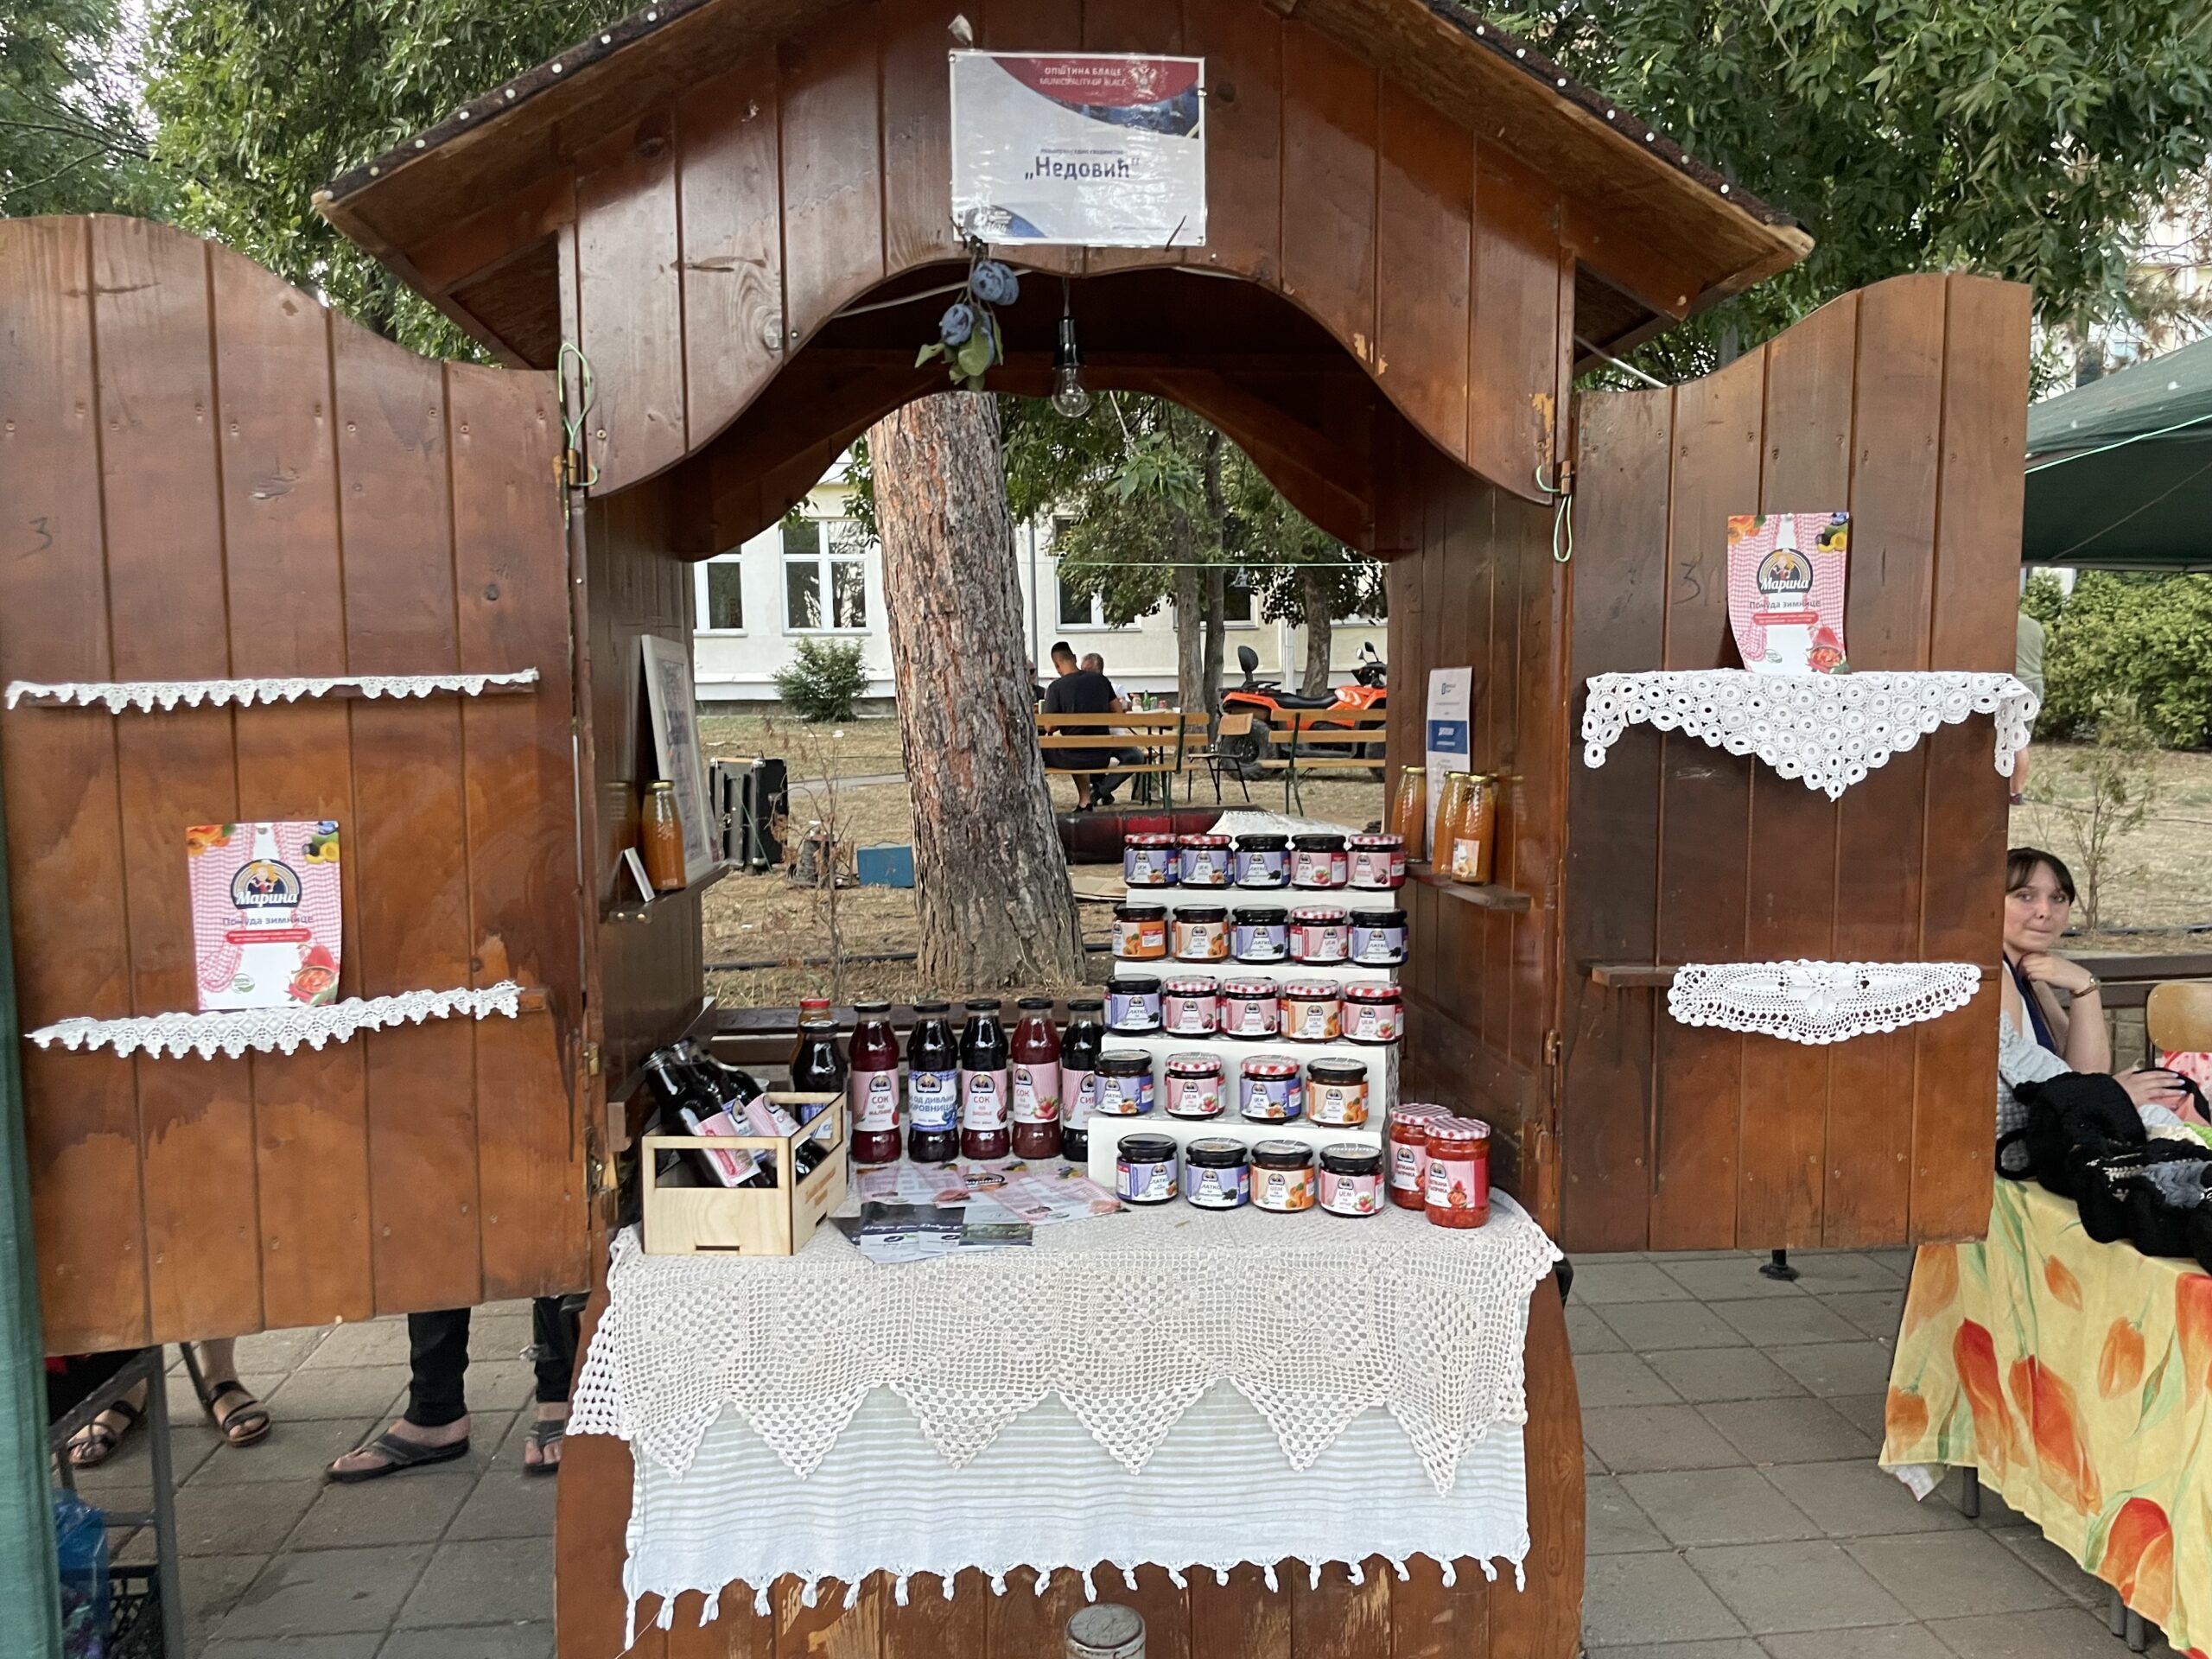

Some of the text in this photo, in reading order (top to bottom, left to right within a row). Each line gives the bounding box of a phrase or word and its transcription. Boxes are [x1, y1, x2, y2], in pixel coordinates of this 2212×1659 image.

[1092, 67, 1122, 76] БЛАЦЕ
[1760, 577, 1808, 594] Марина
[236, 891, 298, 907] Марина
[872, 1096, 889, 1104] СОК
